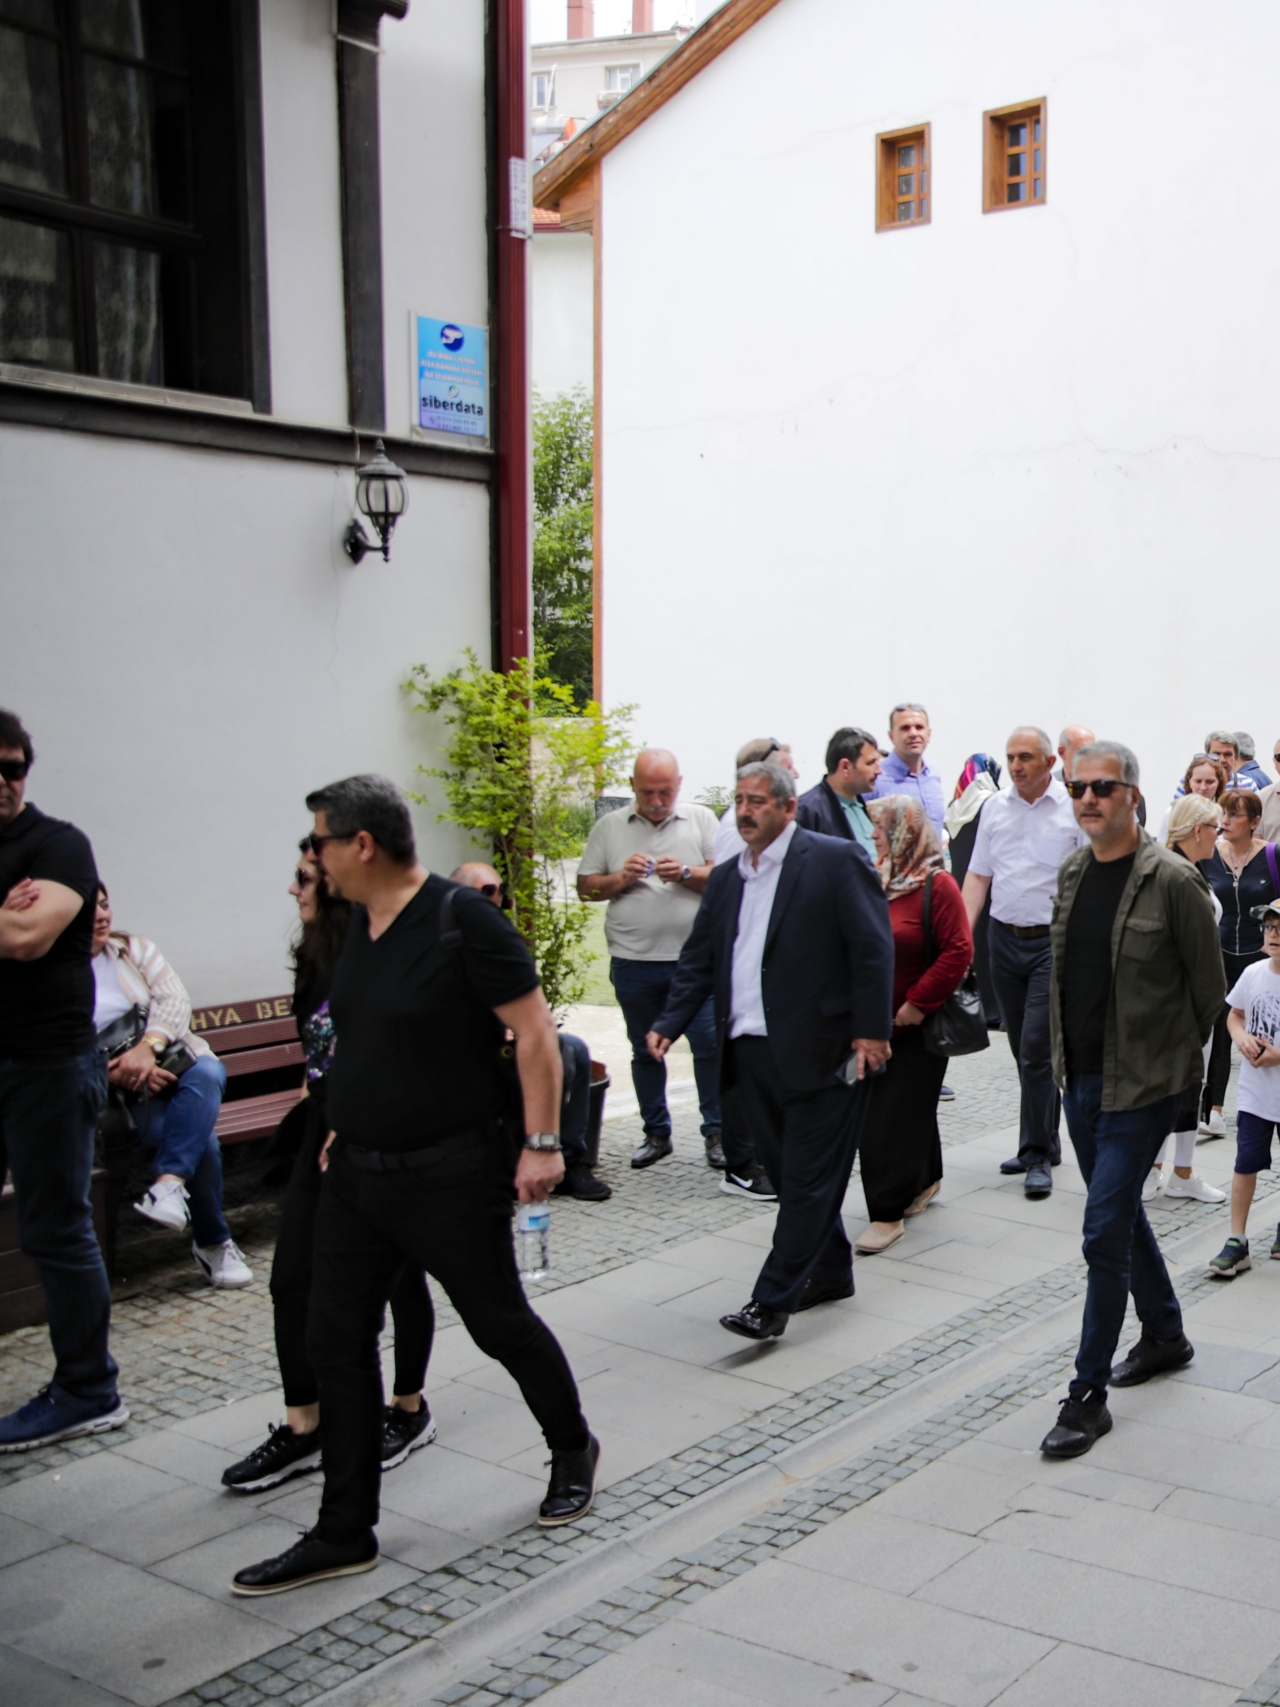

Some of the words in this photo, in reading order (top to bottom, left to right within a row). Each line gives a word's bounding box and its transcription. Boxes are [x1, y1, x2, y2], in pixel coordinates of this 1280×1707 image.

[422, 396, 484, 416] siberdata
[190, 1007, 243, 1030] HYA
[256, 998, 294, 1020] BE
